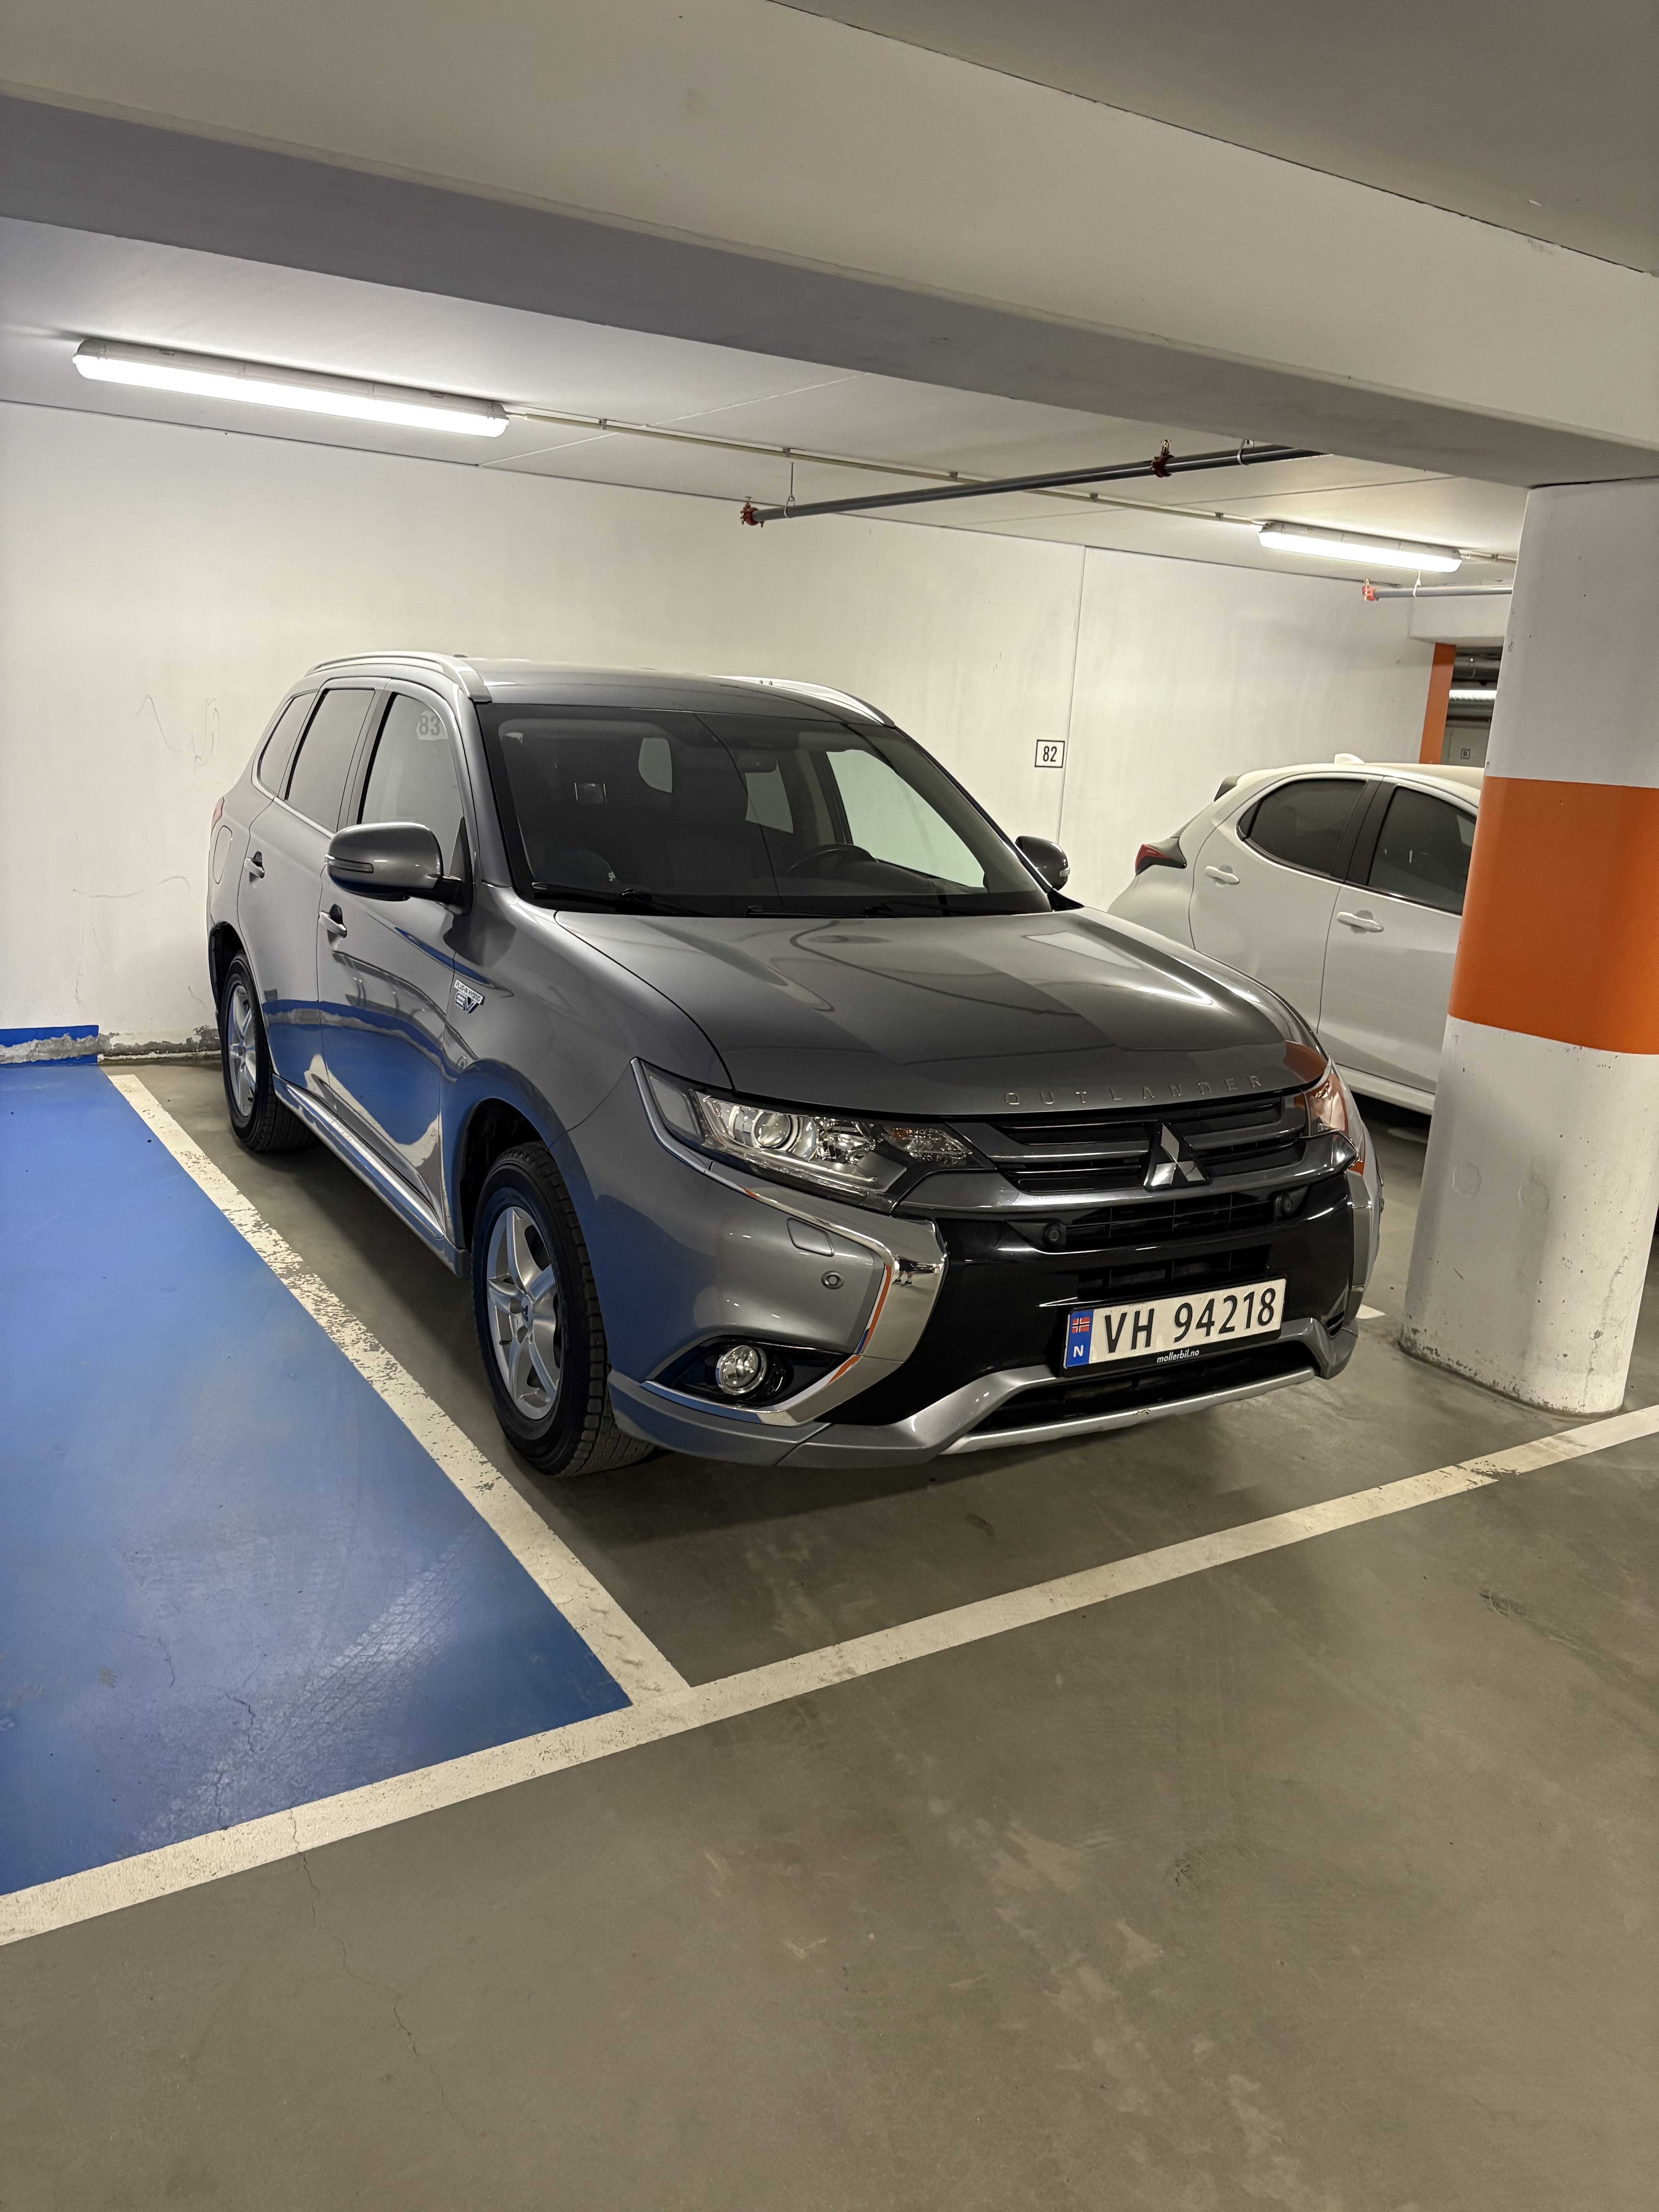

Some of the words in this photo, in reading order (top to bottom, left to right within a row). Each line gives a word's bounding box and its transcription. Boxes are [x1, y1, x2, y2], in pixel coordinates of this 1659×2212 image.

[419, 715, 441, 735] 83
[1043, 746, 1057, 762] 82
[455, 991, 477, 1013] EV
[468, 989, 481, 1002] HYBRID
[1005, 1075, 1262, 1105] OUTLANDER
[1104, 1308, 1155, 1353] VH
[1174, 1288, 1276, 1343] 94218
[1073, 1345, 1084, 1358] N
[1156, 1348, 1200, 1364] mollerbil.no
